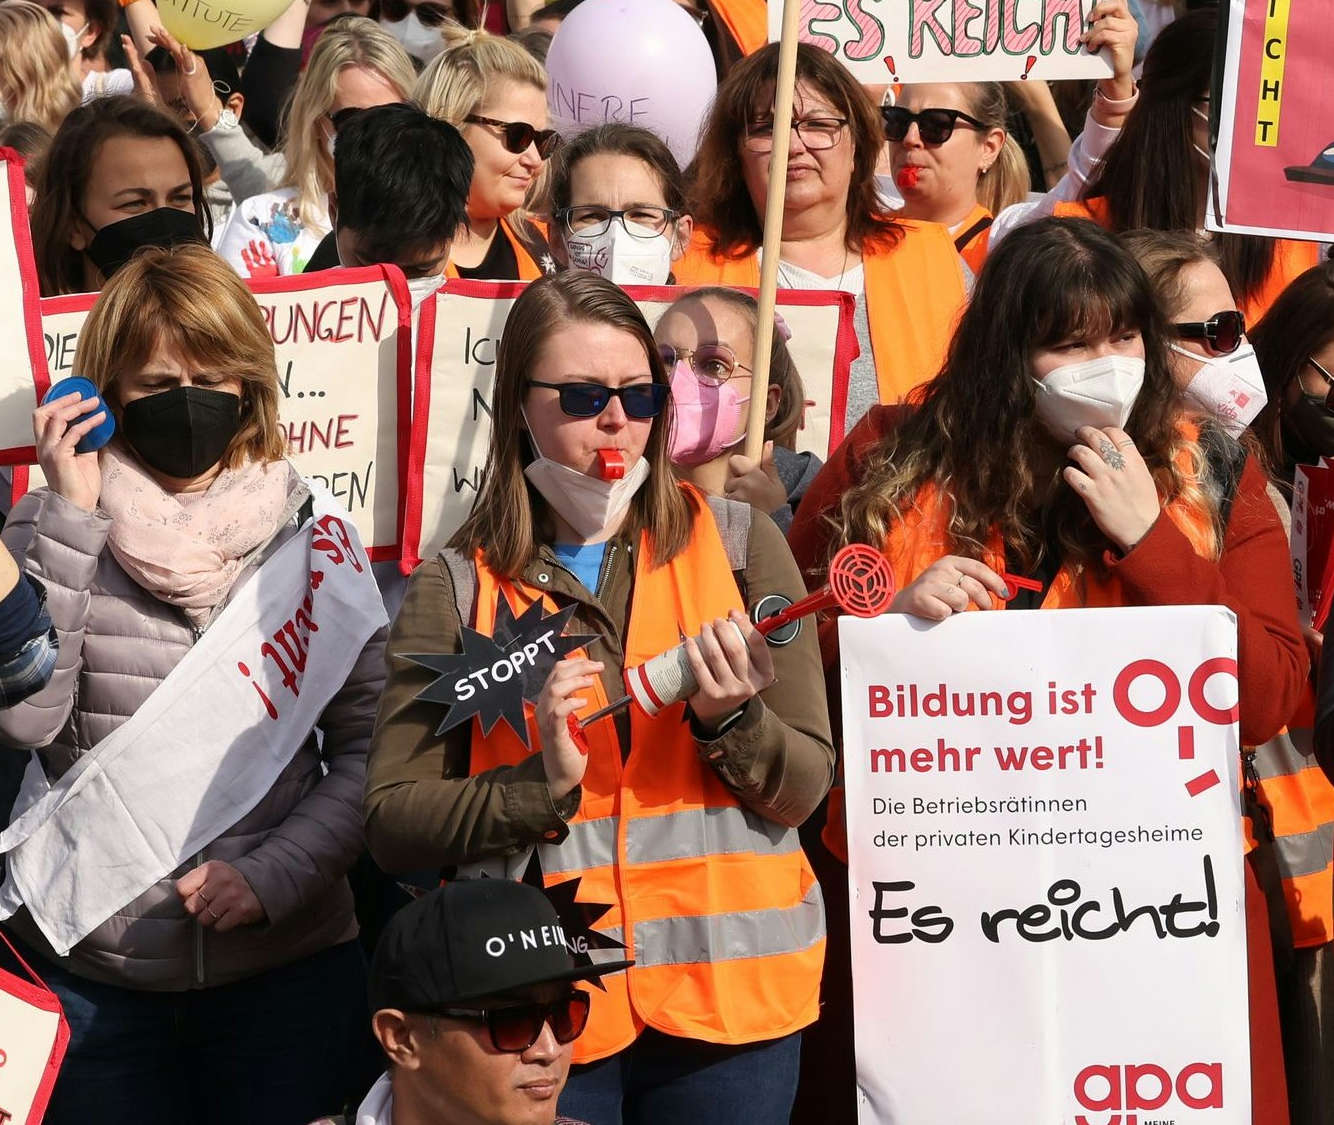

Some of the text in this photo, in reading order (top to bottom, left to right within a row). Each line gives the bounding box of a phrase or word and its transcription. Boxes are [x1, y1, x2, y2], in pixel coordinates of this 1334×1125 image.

[453, 630, 559, 703] STOPPT
[868, 681, 1097, 726] Bildung ist
[870, 735, 1105, 773] mehr wert!
[873, 794, 1088, 816] Die Betriebsrätinnen
[873, 824, 1204, 852] der privaten Kindertagesheime
[868, 854, 1222, 945] Es reicht!
